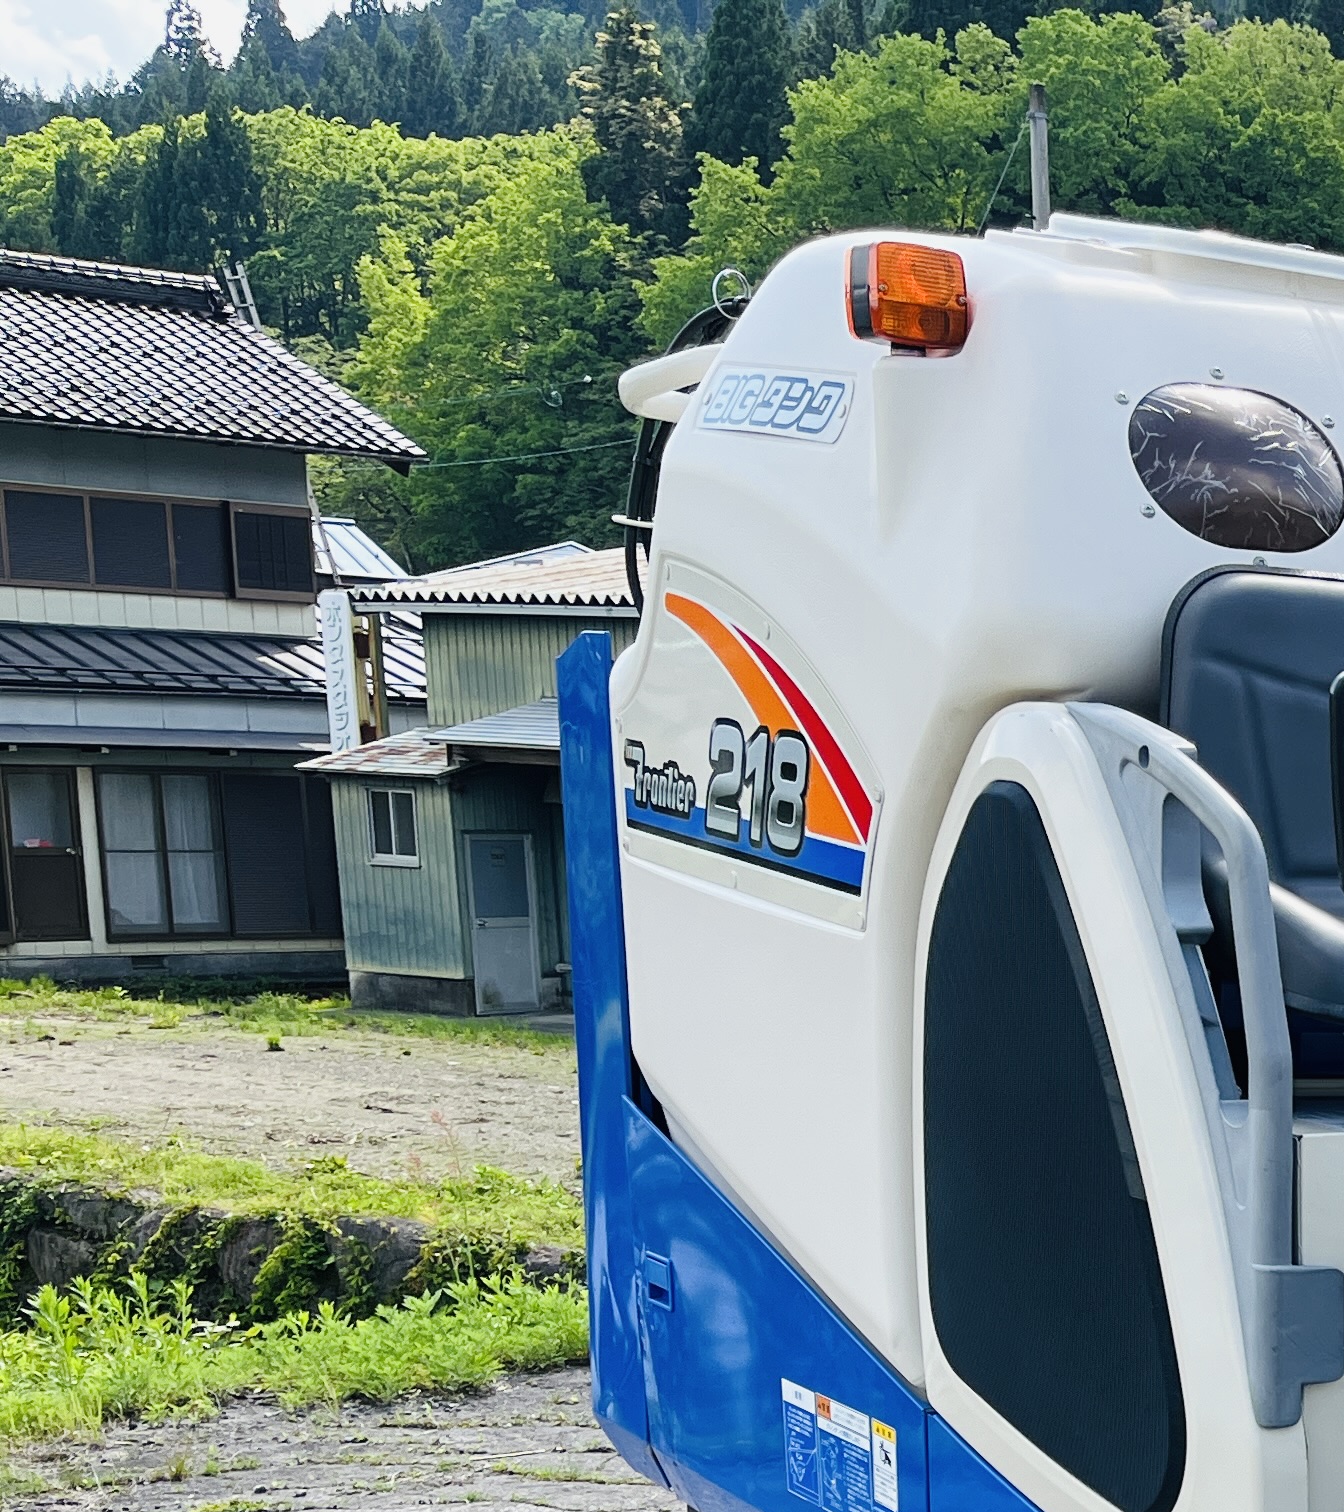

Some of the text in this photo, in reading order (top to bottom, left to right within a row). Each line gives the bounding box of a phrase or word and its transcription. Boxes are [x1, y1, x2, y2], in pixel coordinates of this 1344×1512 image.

[703, 373, 846, 435] BIGタンク
[624, 717, 811, 858] Frontier 218
